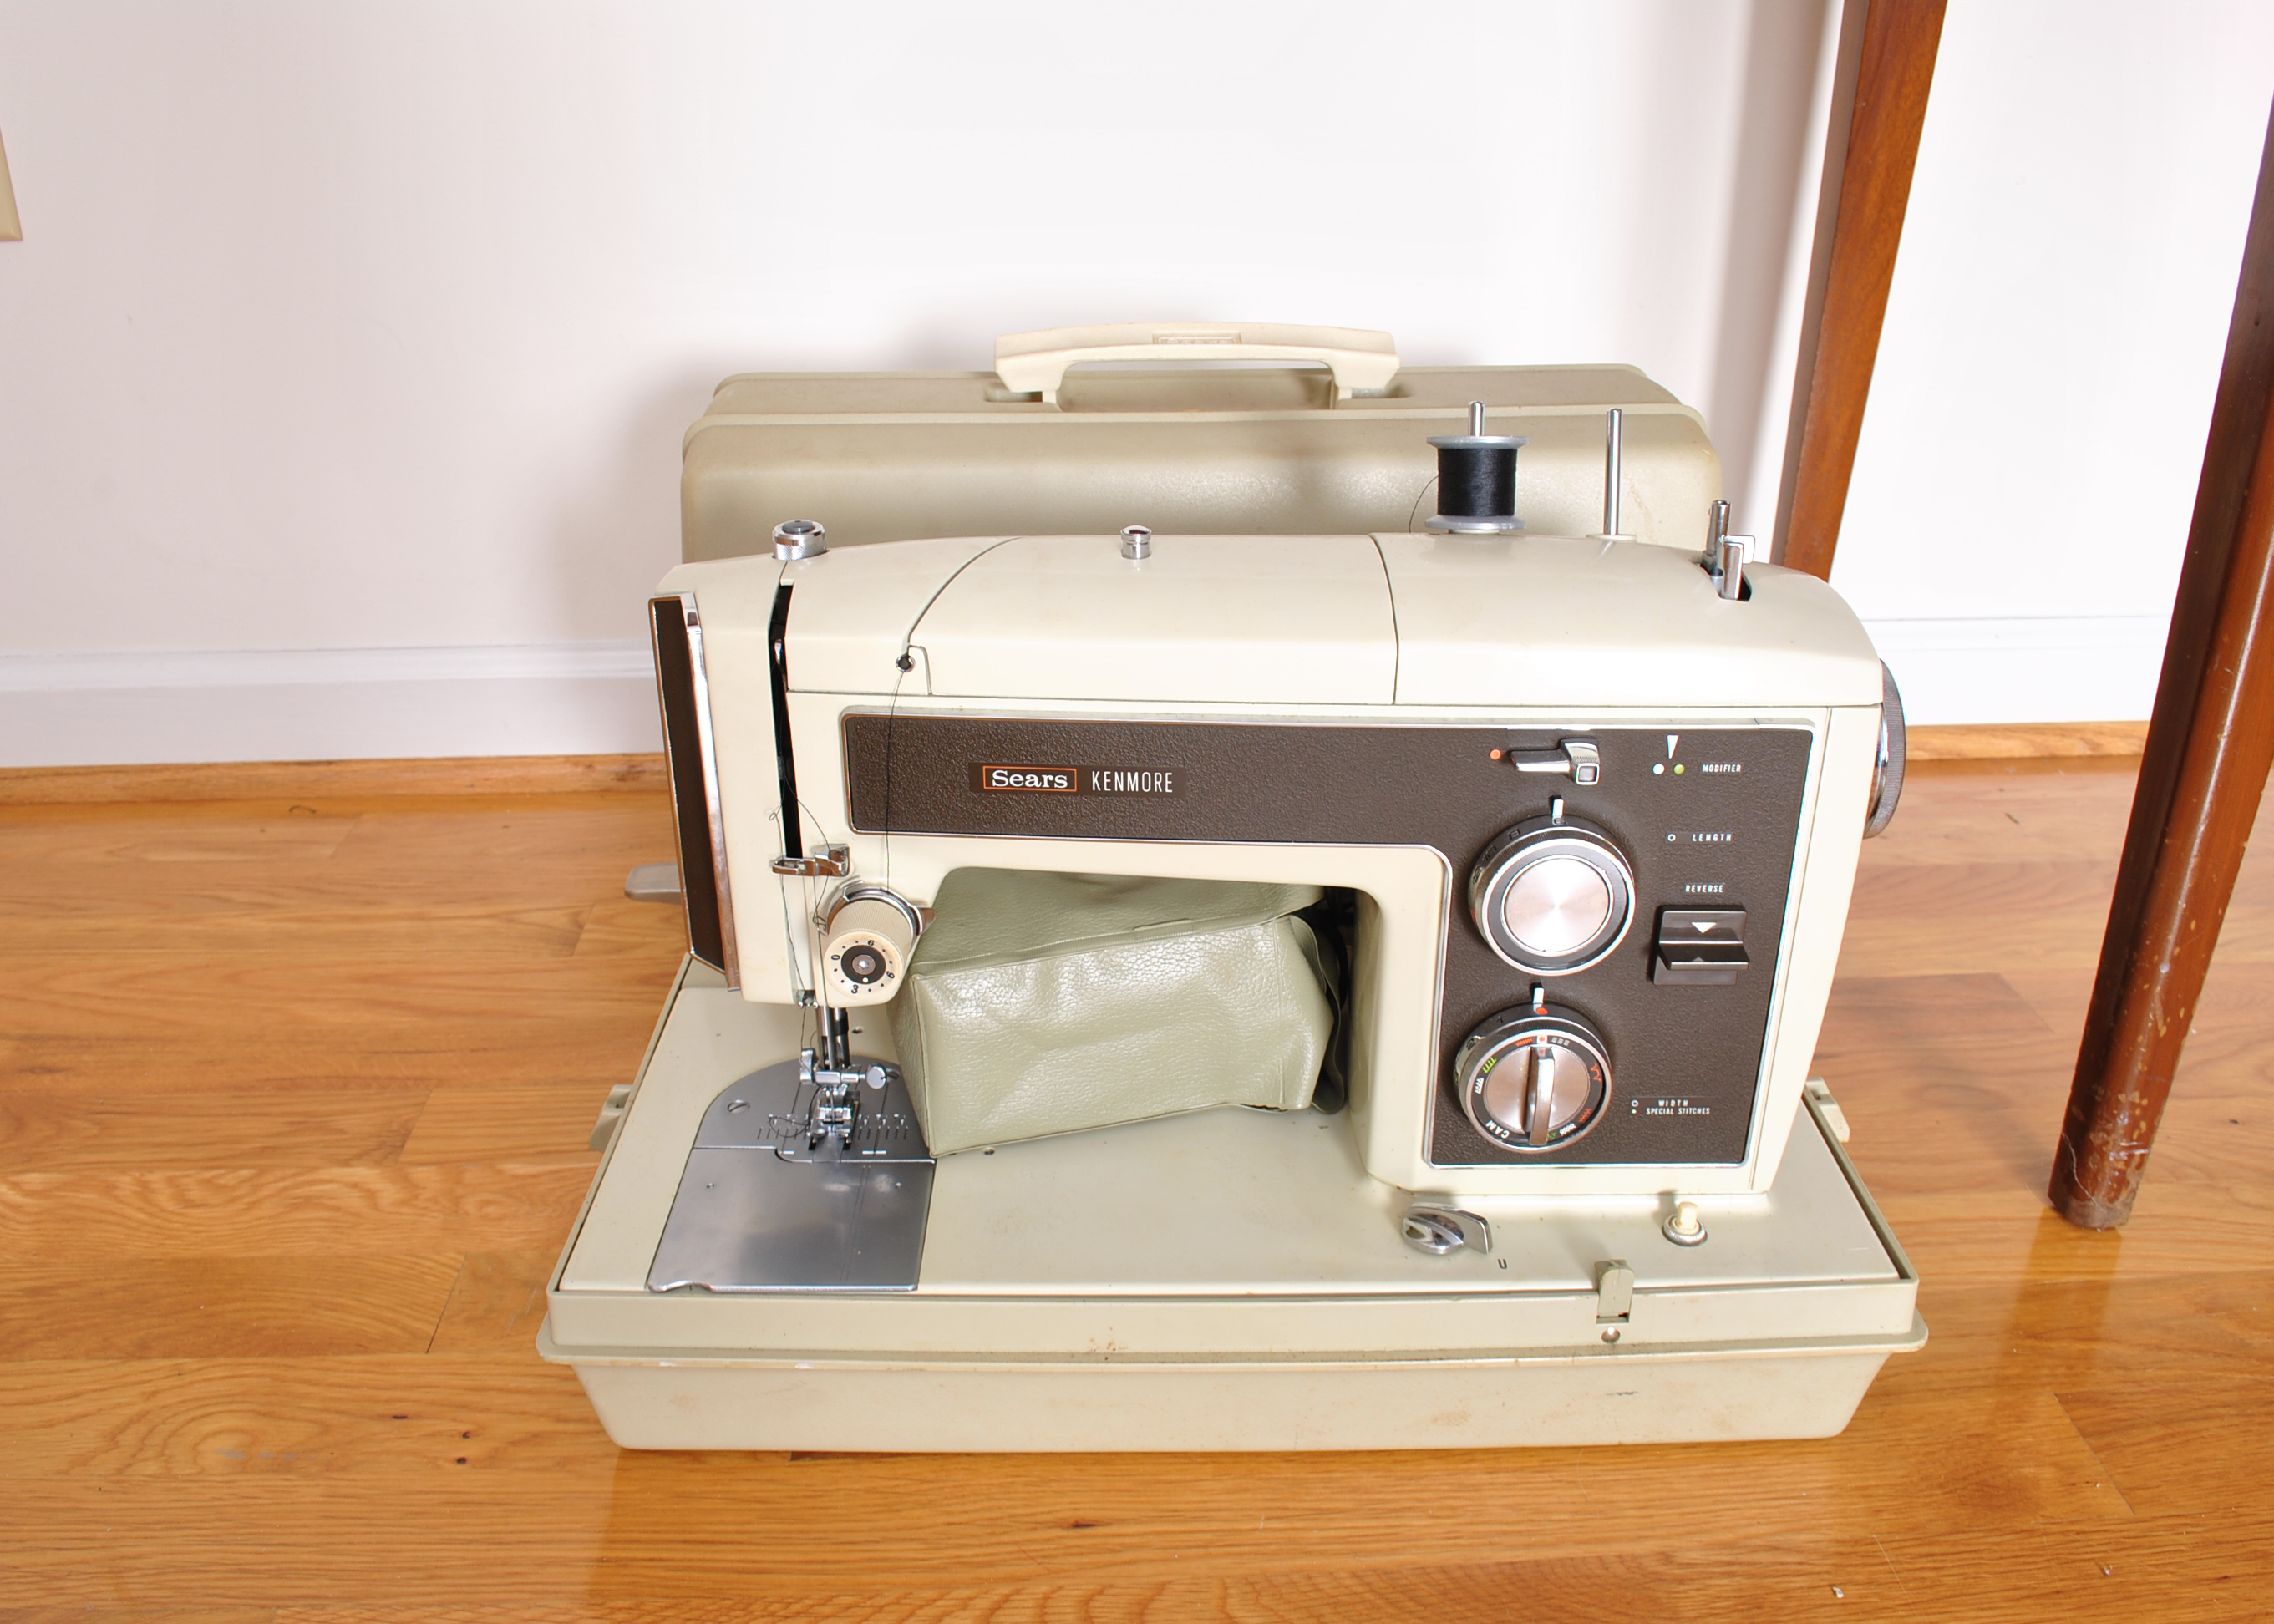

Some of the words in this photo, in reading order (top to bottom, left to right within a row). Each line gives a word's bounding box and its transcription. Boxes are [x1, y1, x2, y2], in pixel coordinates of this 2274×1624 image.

[1702, 763, 1742, 773] MODIFIER
[992, 769, 1068, 789] Sears
[1092, 770, 1173, 793] KENMORE
[1692, 833, 1733, 842] LENGTH
[1685, 883, 1725, 893] REVERSE
[851, 984, 859, 994] 3
[1658, 1099, 1689, 1107] WIDTH
[1646, 1107, 1674, 1115] SPECIAL
[1678, 1107, 1711, 1115] STITCHES
[1485, 1119, 1510, 1139] CAM
[1497, 1259, 1508, 1270] U
